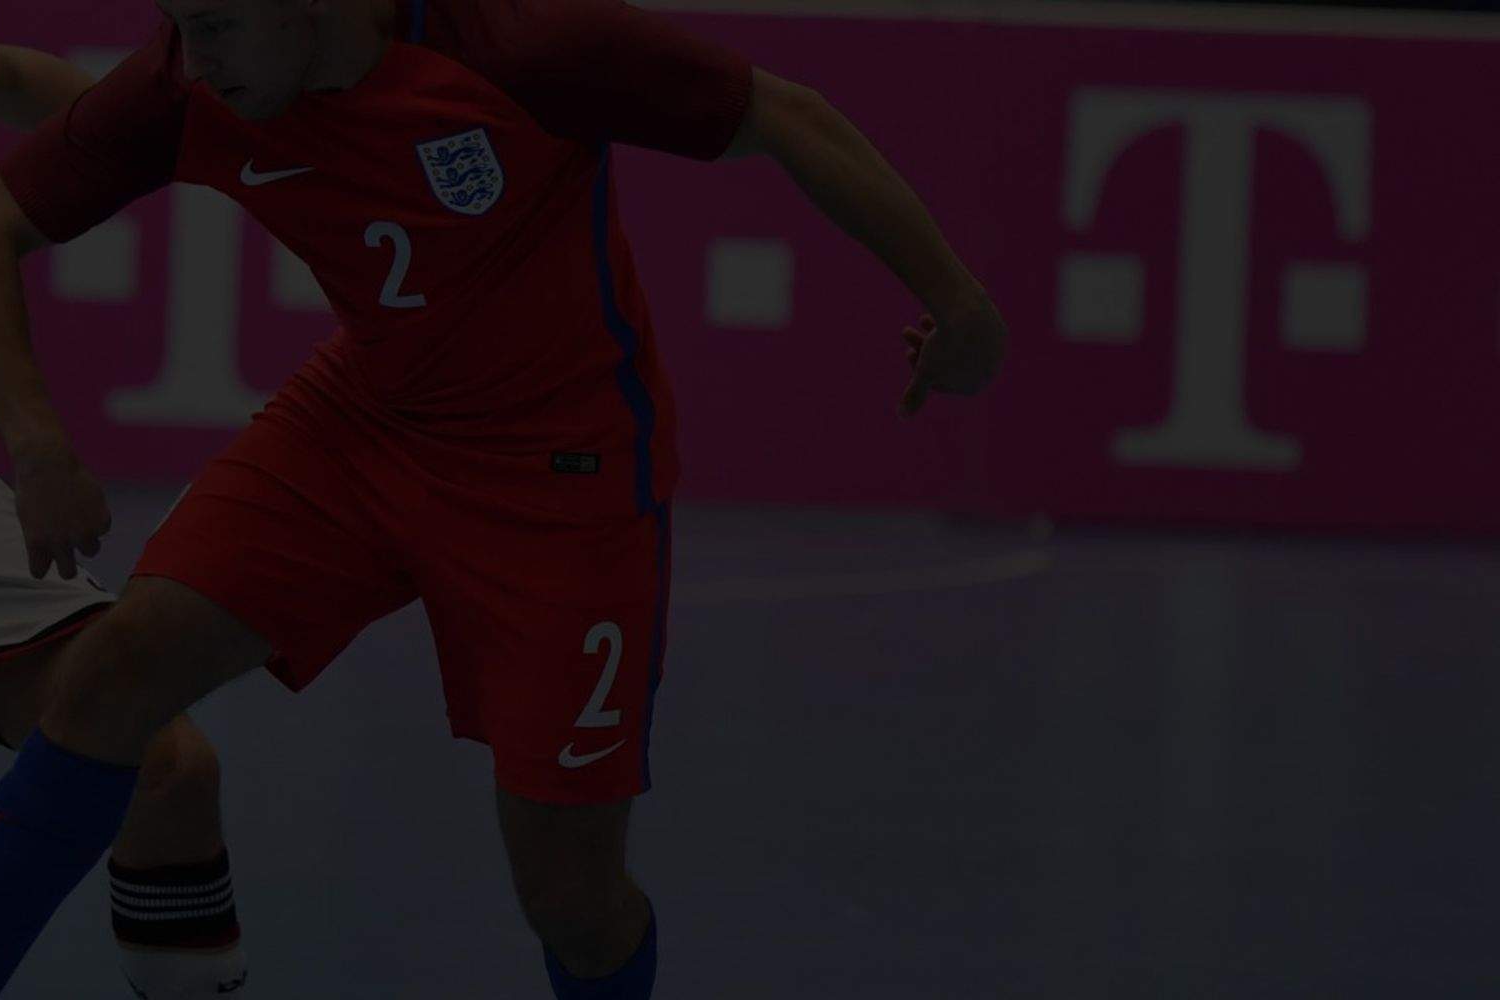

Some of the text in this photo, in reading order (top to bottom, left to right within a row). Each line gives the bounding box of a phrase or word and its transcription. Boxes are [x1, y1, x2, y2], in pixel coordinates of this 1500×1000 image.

[364, 221, 427, 308] 2
[1059, 84, 1374, 472] T
[573, 621, 624, 728] 2
